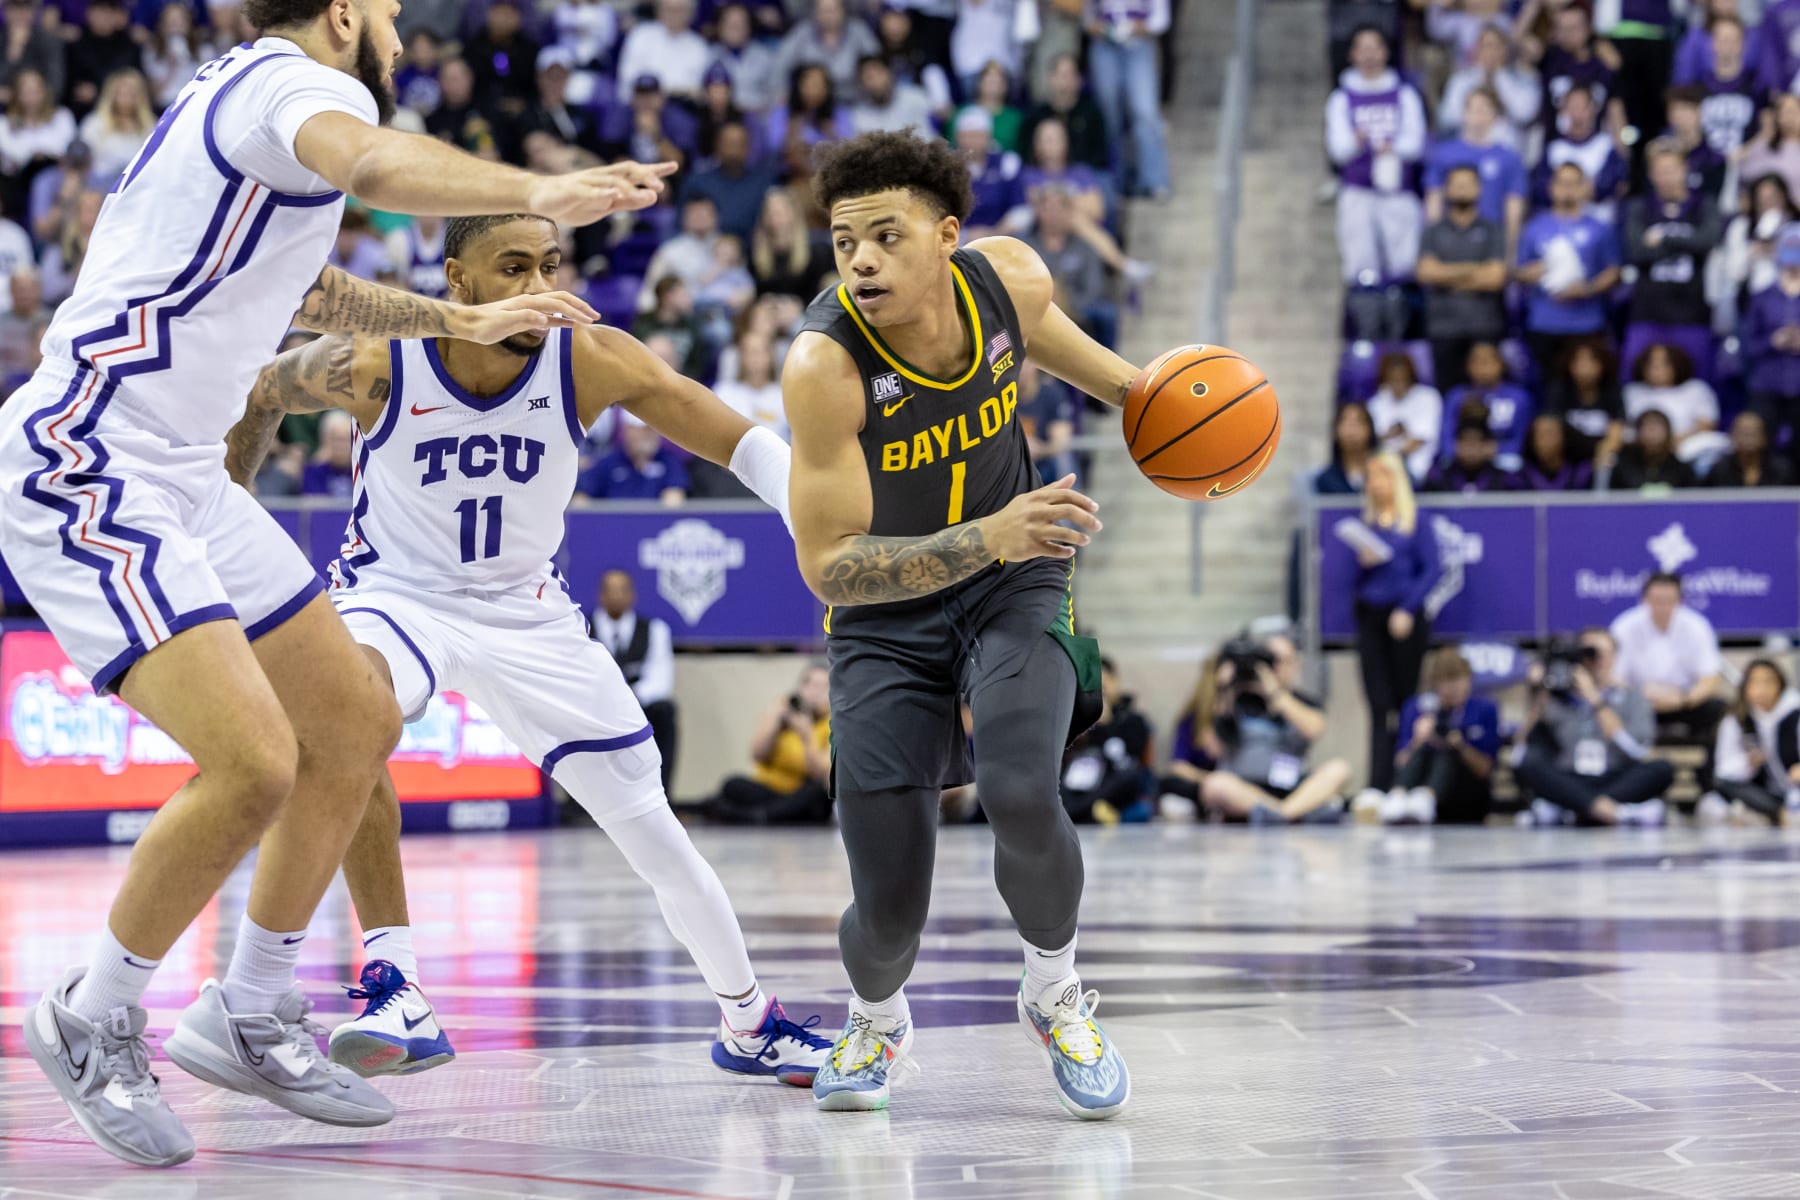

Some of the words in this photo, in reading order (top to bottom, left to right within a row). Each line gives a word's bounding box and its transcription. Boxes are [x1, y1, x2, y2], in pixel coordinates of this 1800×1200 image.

[528, 396, 551, 411] XII
[874, 373, 900, 396] ONE
[881, 381, 1018, 472] BAYLOR
[414, 434, 546, 487] TCU
[947, 461, 966, 525] 1
[453, 495, 503, 563] 11
